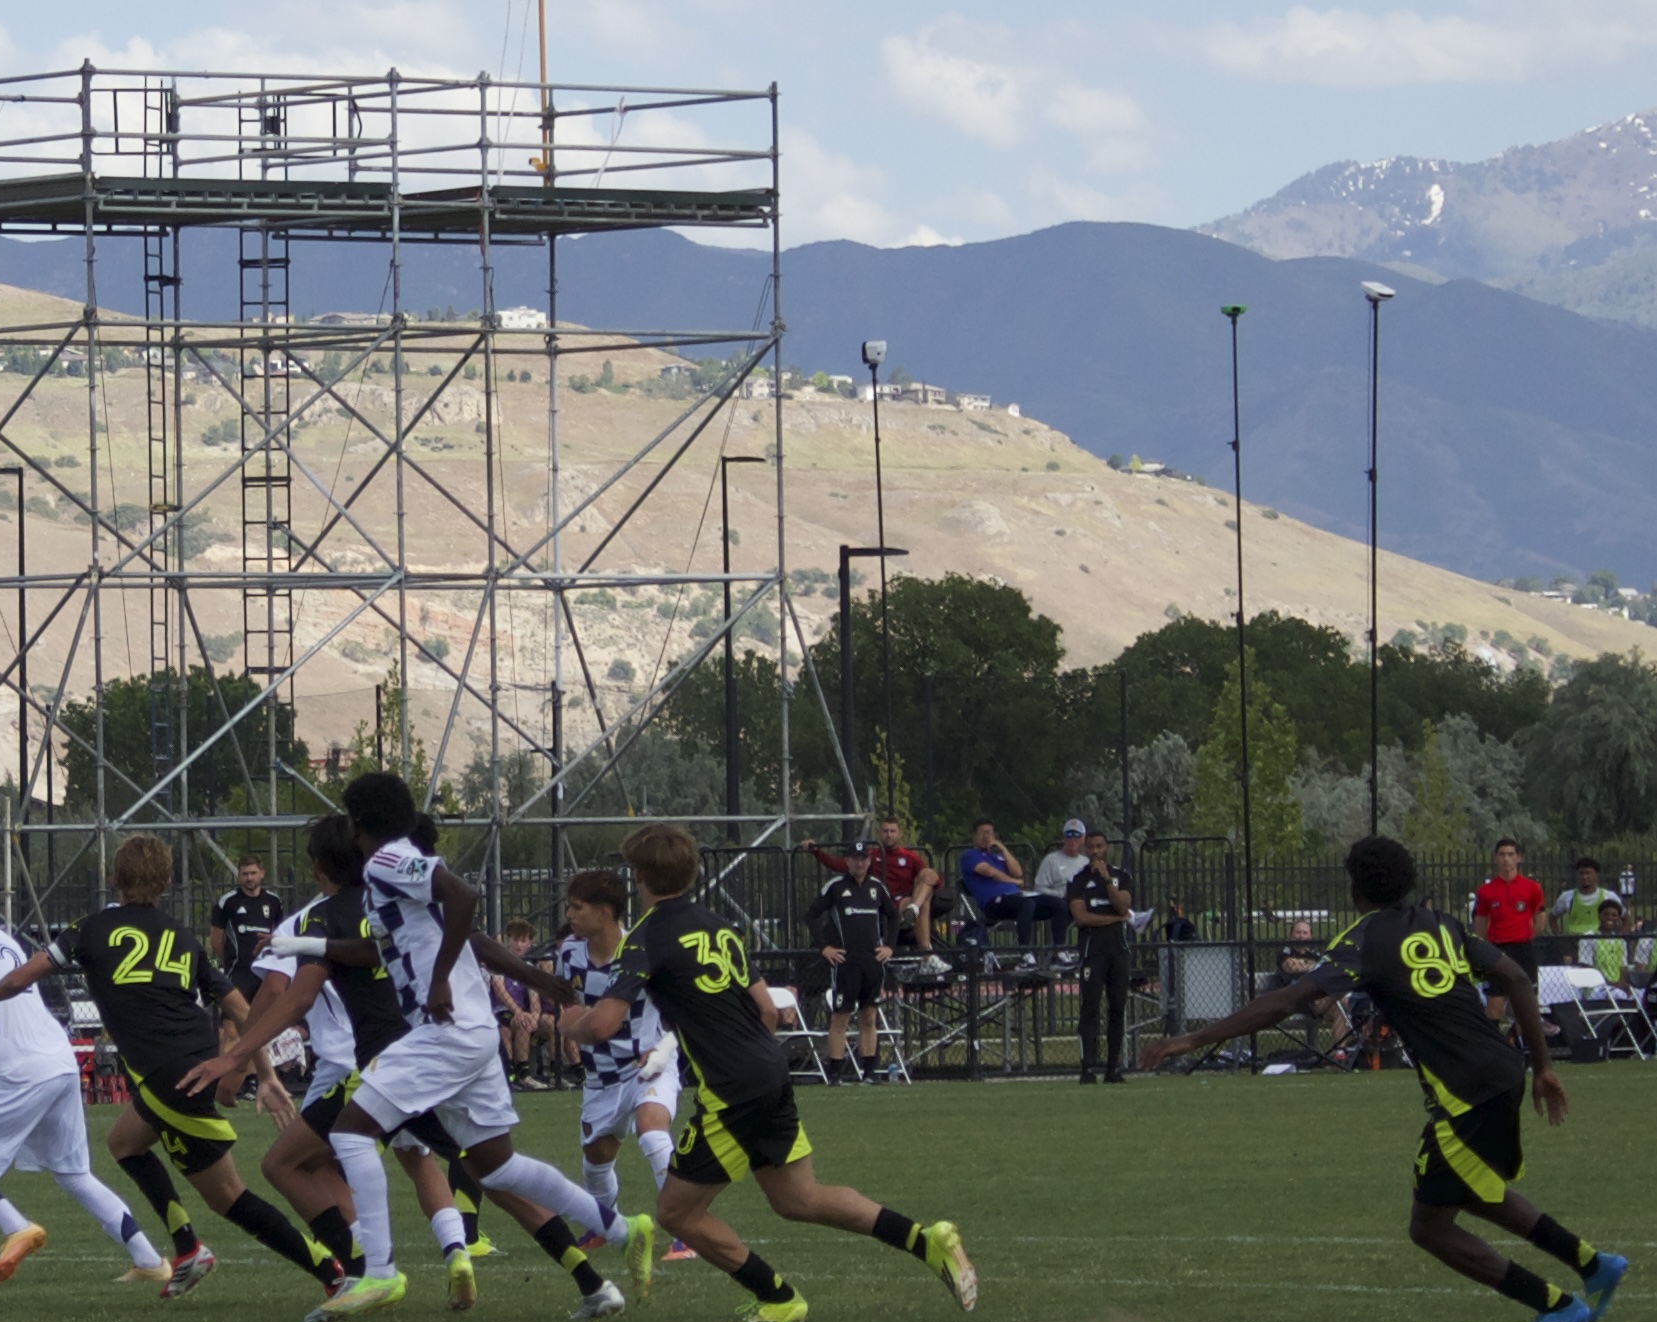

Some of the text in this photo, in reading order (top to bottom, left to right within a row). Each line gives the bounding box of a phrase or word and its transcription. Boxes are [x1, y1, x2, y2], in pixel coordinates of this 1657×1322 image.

[108, 926, 192, 990] 24
[678, 928, 749, 993] 30
[1400, 925, 1473, 997] 84
